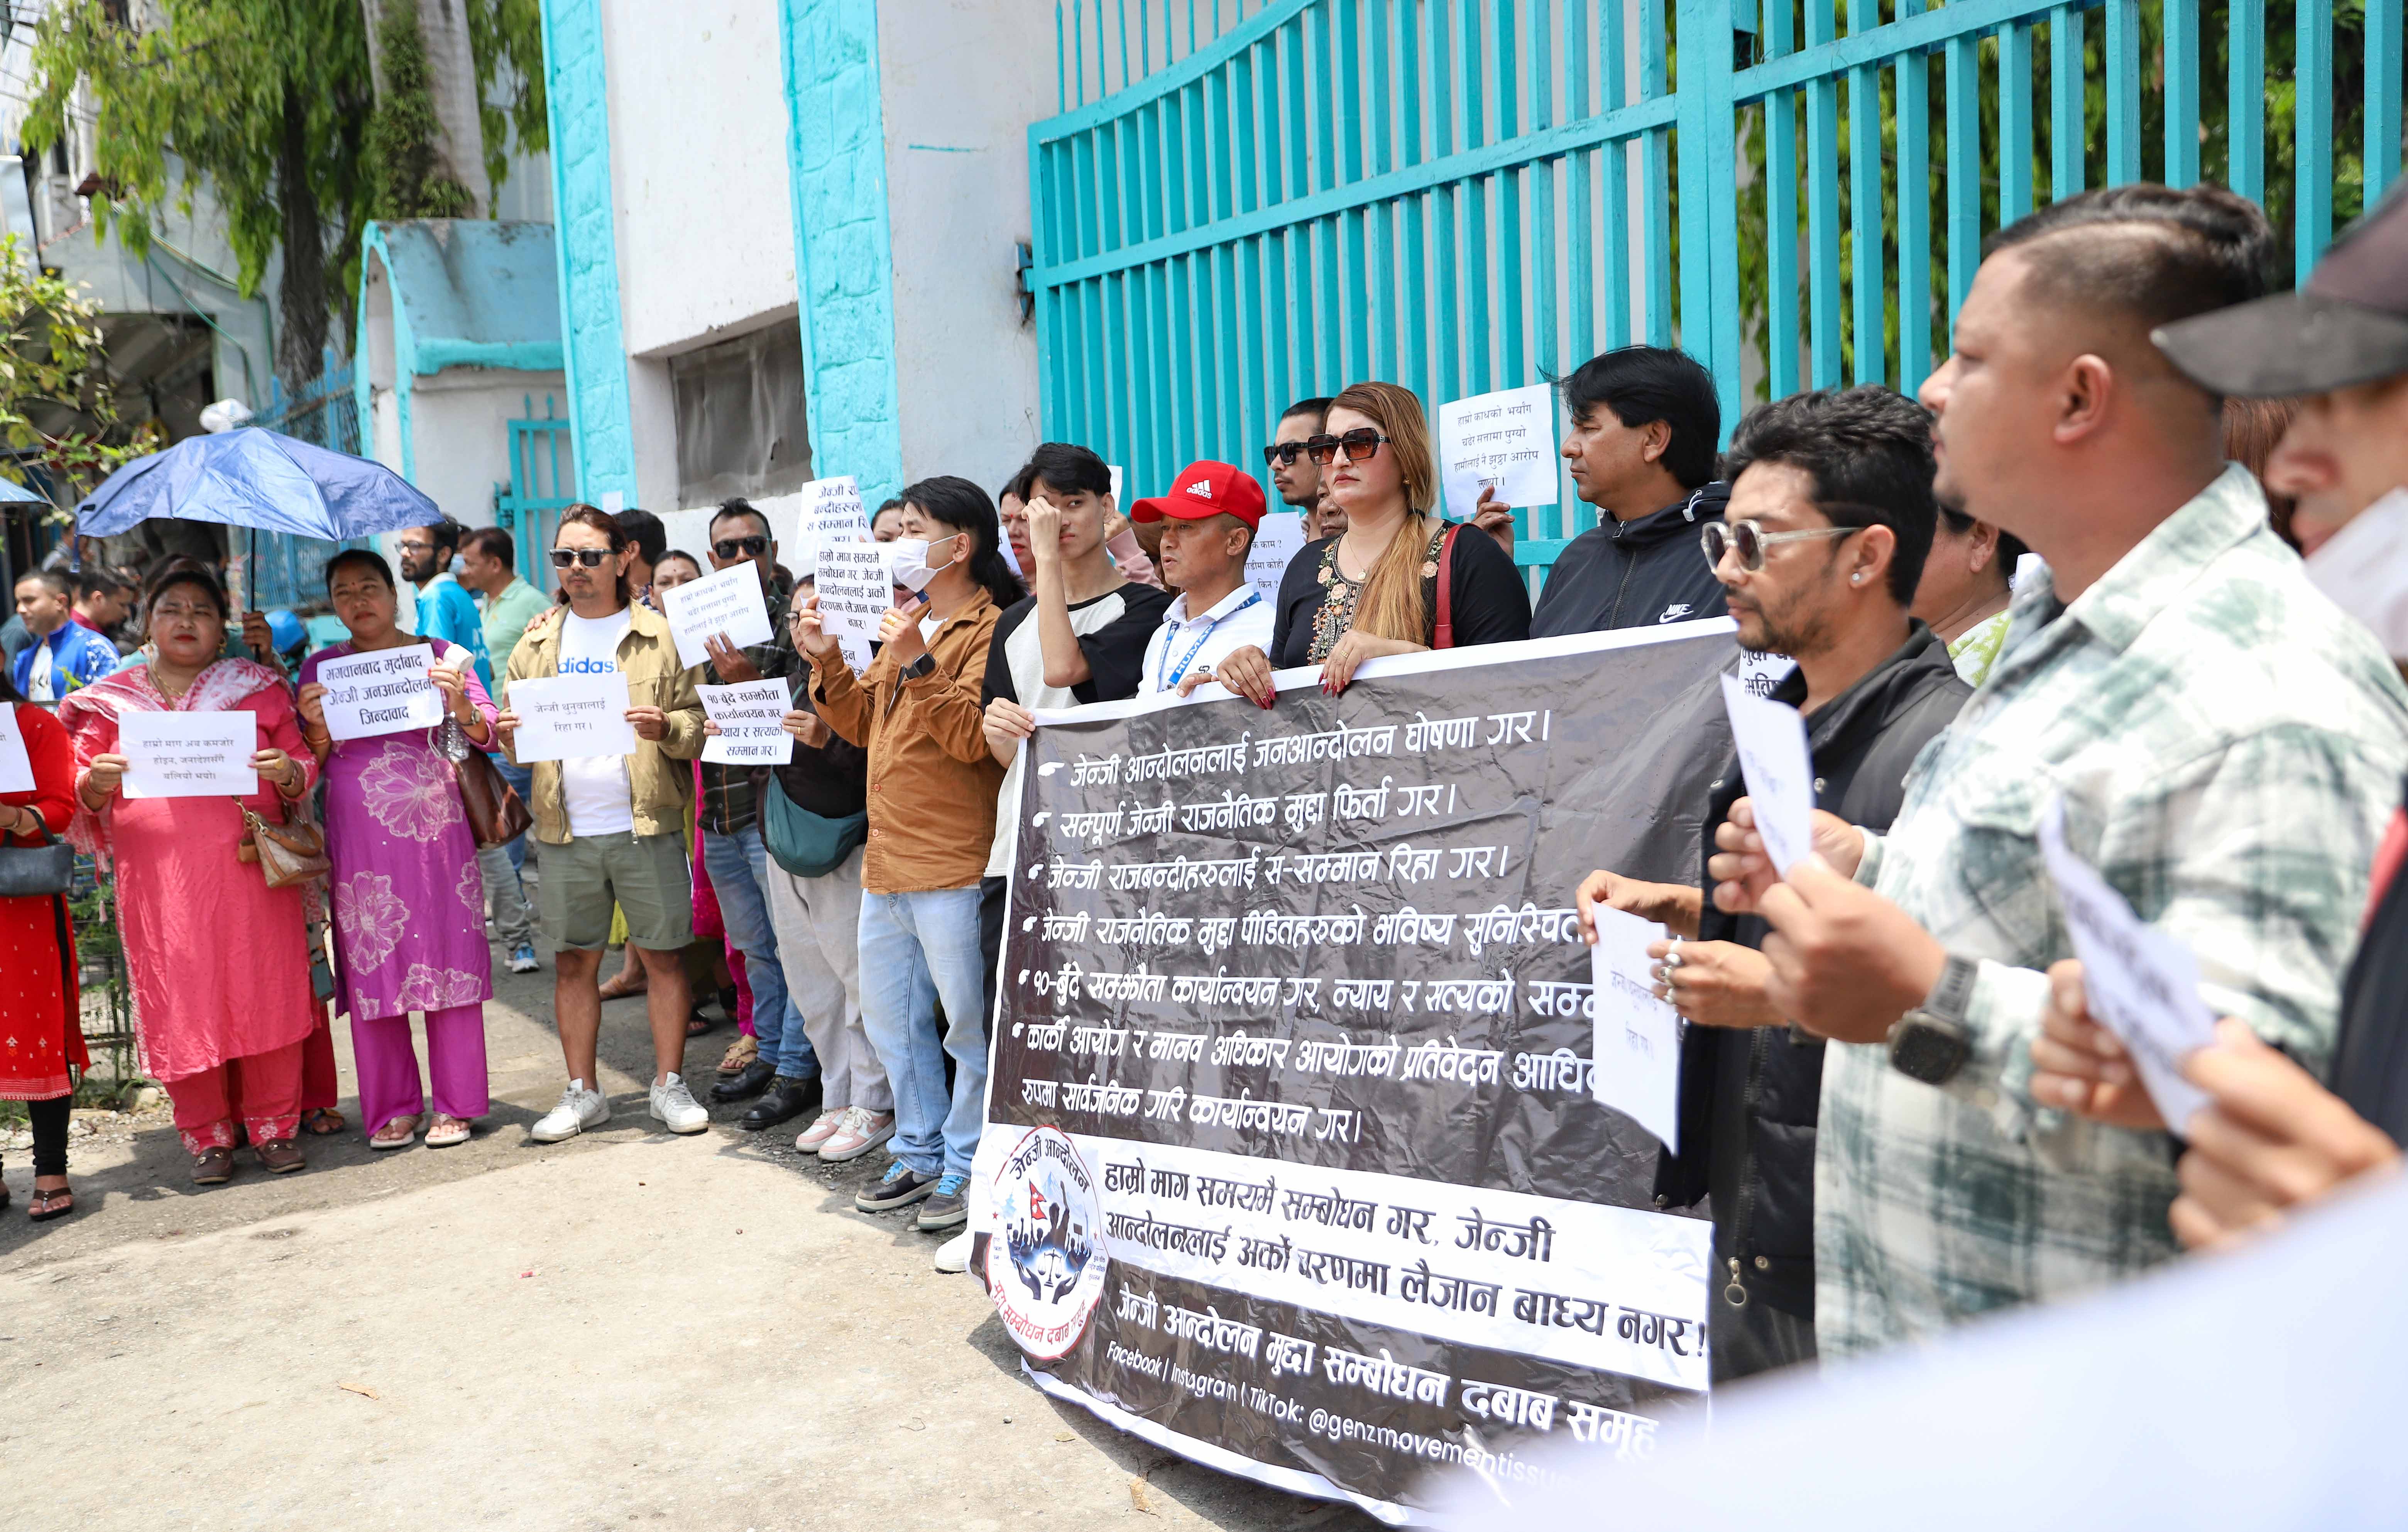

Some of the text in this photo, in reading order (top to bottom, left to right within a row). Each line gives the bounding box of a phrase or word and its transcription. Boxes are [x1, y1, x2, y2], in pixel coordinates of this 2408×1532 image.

[1458, 412, 1471, 426] हाम्रो
[1477, 431, 1502, 443] सत्तामा
[1505, 425, 1526, 443] पुग्यो
[1454, 454, 1480, 472] हामीलाई
[1482, 453, 1486, 465] नै
[1510, 448, 1539, 461] आरोप
[819, 484, 844, 498] जेन्जी
[1186, 487, 1212, 499] adidas
[819, 549, 879, 563] हाम्रो माग समयमै
[1267, 558, 1283, 568] कोही
[818, 566, 845, 579] सम्बोधन
[862, 568, 884, 581] जेन्जी
[819, 583, 864, 598] आन्दोलनलाई
[1258, 578, 1272, 588] किन
[844, 600, 869, 614] लैजान
[1665, 604, 1689, 615] NIKE
[1175, 624, 1214, 674] HUMAN
[558, 657, 614, 673] didas
[329, 678, 432, 705] जेन्जी जनआन्दोलन
[534, 702, 558, 713] जेन्जी
[714, 709, 765, 720] कार्यान्वयन
[554, 722, 572, 732] रिहा
[743, 727, 749, 737] र
[726, 746, 758, 756] सम्मान
[1069, 754, 1121, 786] जेन्जी
[1124, 731, 1249, 785] आन्दोलनलाई
[1253, 720, 1397, 764] जनआन्दोलन
[1405, 711, 1478, 752] घोषणा
[1059, 802, 1125, 845] सम्पूर्ण
[1126, 800, 1175, 835] जेन्जी
[1180, 789, 1278, 830] राजनैतिक
[1285, 793, 1327, 831] मुद्दा
[1333, 776, 1392, 820] फिर्ता
[1047, 854, 1103, 889] जेन्जी
[1264, 851, 1382, 884] स-सम्मान
[1388, 843, 1442, 884] रिहा
[1041, 907, 1090, 942] जेन्जी
[1096, 905, 1193, 945] राजनैतिक
[1197, 917, 1238, 955] मुद्दा
[1373, 906, 1457, 945] भविष्य
[1171, 965, 1281, 1006] कार्यान्वयन
[1333, 980, 1394, 1011] न्याय
[1401, 981, 1420, 1012] र
[1424, 967, 1515, 1012] सत्यको
[1027, 1016, 1070, 1052] कार्की
[1069, 1019, 1128, 1056] आयोग
[1133, 1032, 1152, 1058] र
[1149, 1032, 1207, 1063] मानव
[1211, 1030, 1292, 1069] अधिकार
[1295, 1033, 1401, 1077] आयोगको
[1399, 1035, 1503, 1087] प्रतिवेदन
[1062, 1073, 1143, 1116] सार्वजनिक
[1145, 1086, 1187, 1122] गरि
[1189, 1088, 1312, 1136] कार्यान्वयन
[1010, 1134, 1089, 1193] जेन्जी आन्दोलन
[1105, 1157, 1145, 1196] हाम्रो
[1150, 1169, 1190, 1200] माग
[1196, 1175, 1277, 1215] समयमै
[1282, 1187, 1378, 1232] सम्बोधन
[1455, 1207, 1556, 1262] जेन्जी
[1106, 1210, 1232, 1266] आन्दोलनलाई
[1401, 1258, 1502, 1317] लैजान
[1513, 1288, 1608, 1336] बाध्य
[1003, 1304, 1045, 1343] सम्बोधन
[1047, 1322, 1069, 1344] दबाब
[1116, 1282, 1158, 1330] जेन्जी
[1163, 1305, 1262, 1358] आन्दोलन
[1266, 1331, 1316, 1375] मुद्दा
[1322, 1348, 1451, 1407] सम्बोधन
[1461, 1378, 1558, 1431] दबाब
[1106, 1340, 1162, 1378] Facebook
[1172, 1361, 1237, 1402] Instagram
[1250, 1386, 1304, 1424] TikTok:
